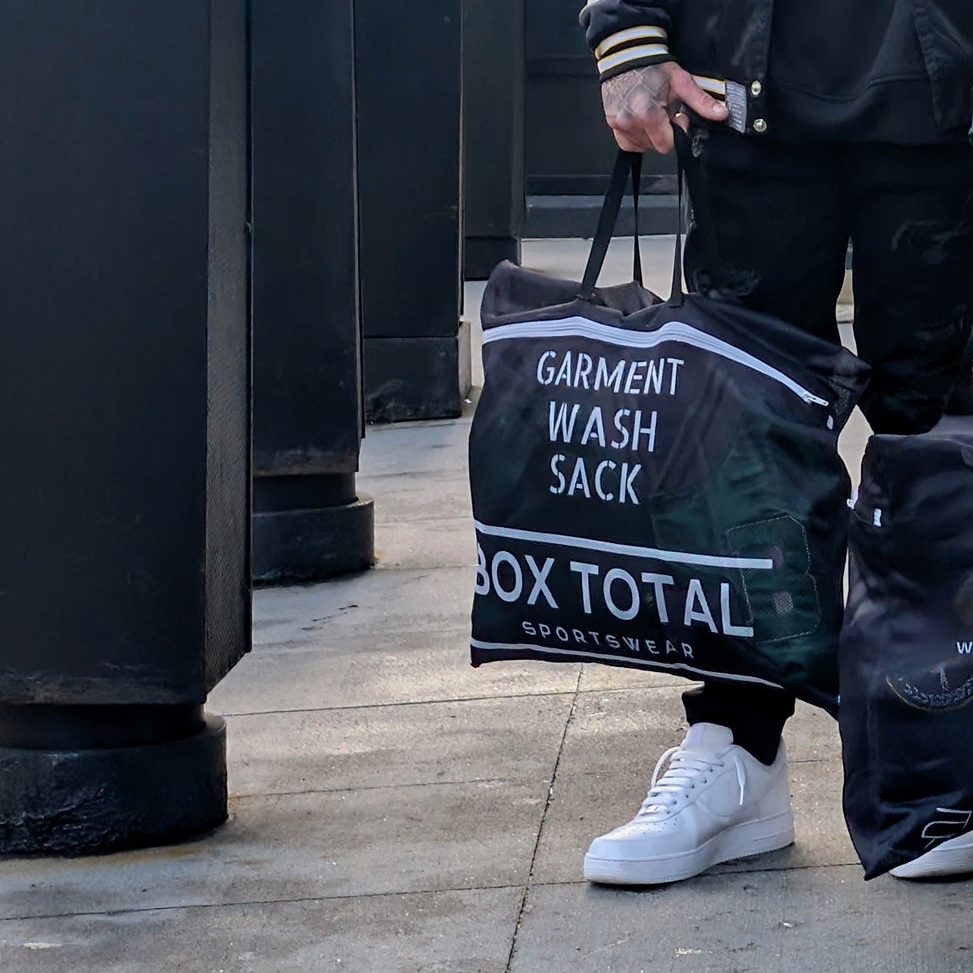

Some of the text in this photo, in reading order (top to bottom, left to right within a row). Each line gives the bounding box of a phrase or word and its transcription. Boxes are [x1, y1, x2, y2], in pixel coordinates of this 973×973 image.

[536, 349, 684, 396] GARMENT
[548, 400, 657, 453] WASH
[549, 453, 643, 505] SACK
[569, 559, 755, 638] TOTAL
[521, 620, 695, 659] SPORTSWEAR
